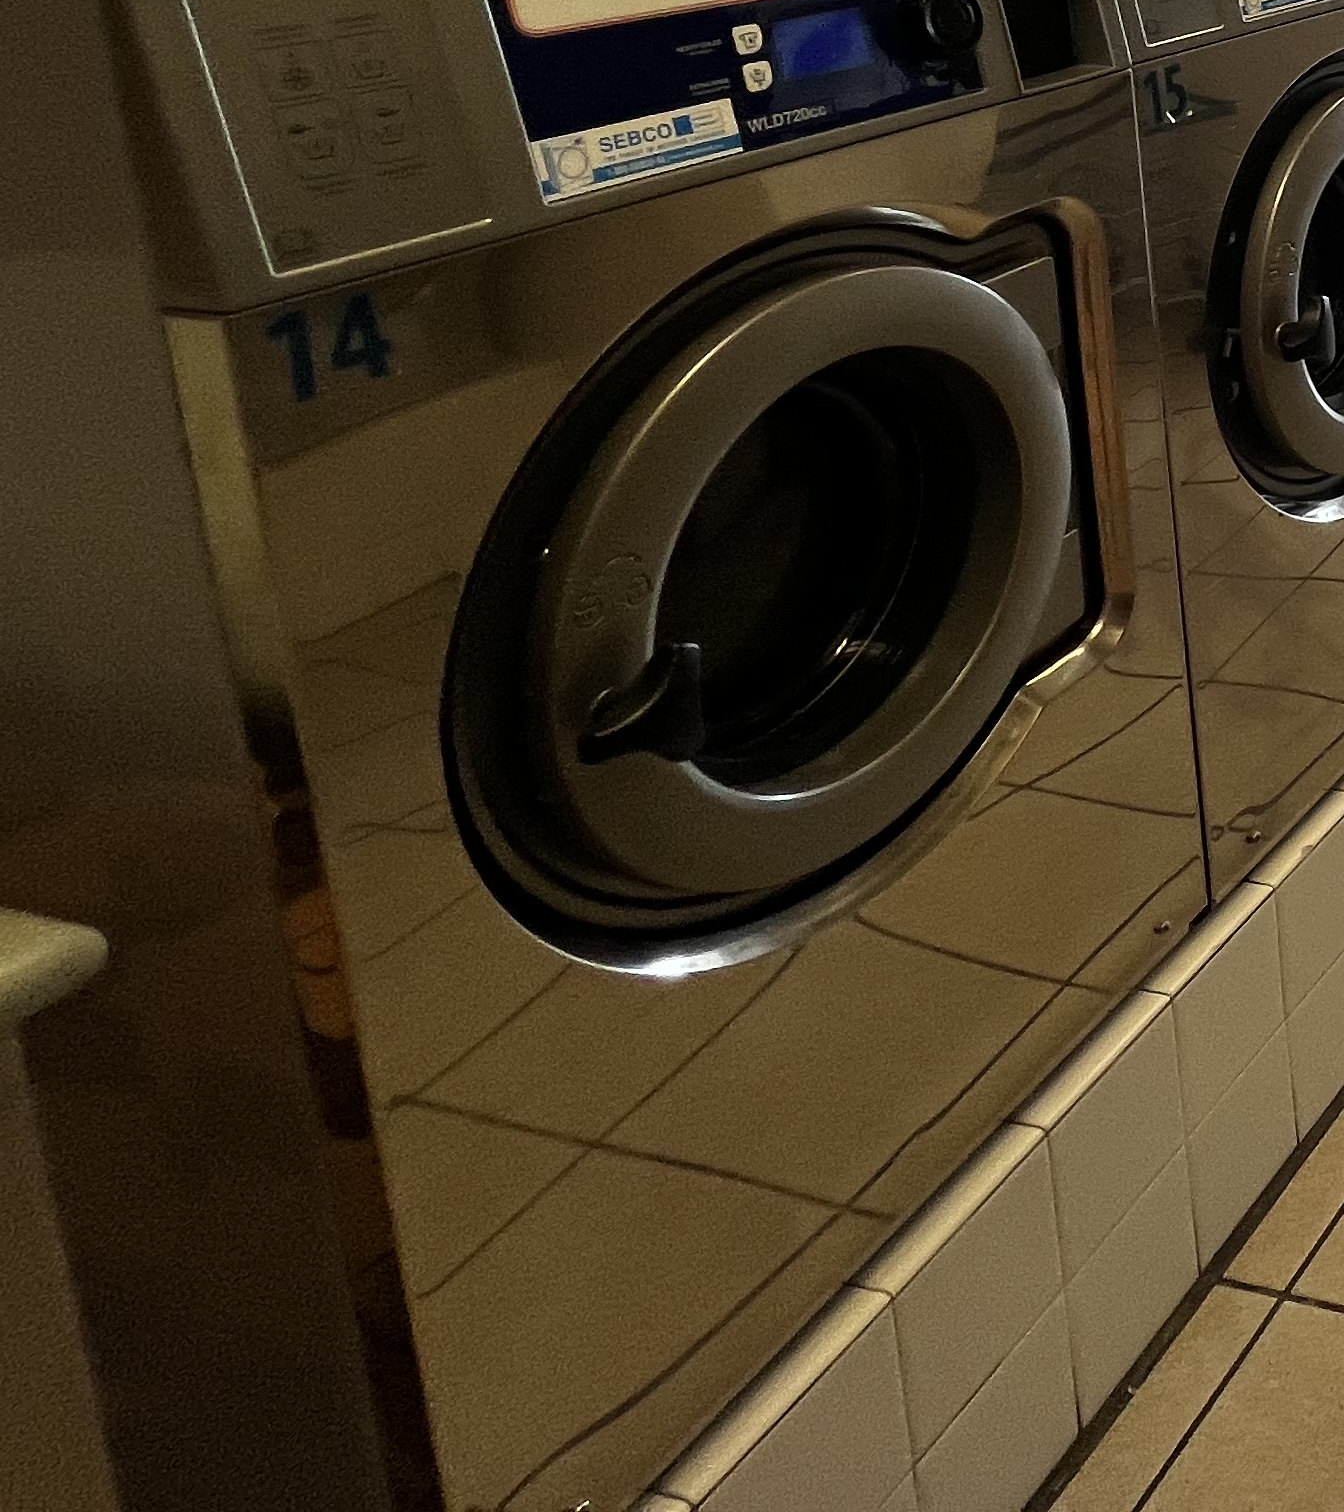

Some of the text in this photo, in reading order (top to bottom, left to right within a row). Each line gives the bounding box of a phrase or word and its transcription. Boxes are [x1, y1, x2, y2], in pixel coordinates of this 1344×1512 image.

[1143, 63, 1187, 126] 15
[599, 122, 673, 153] SEBCO
[265, 292, 392, 402] 14
